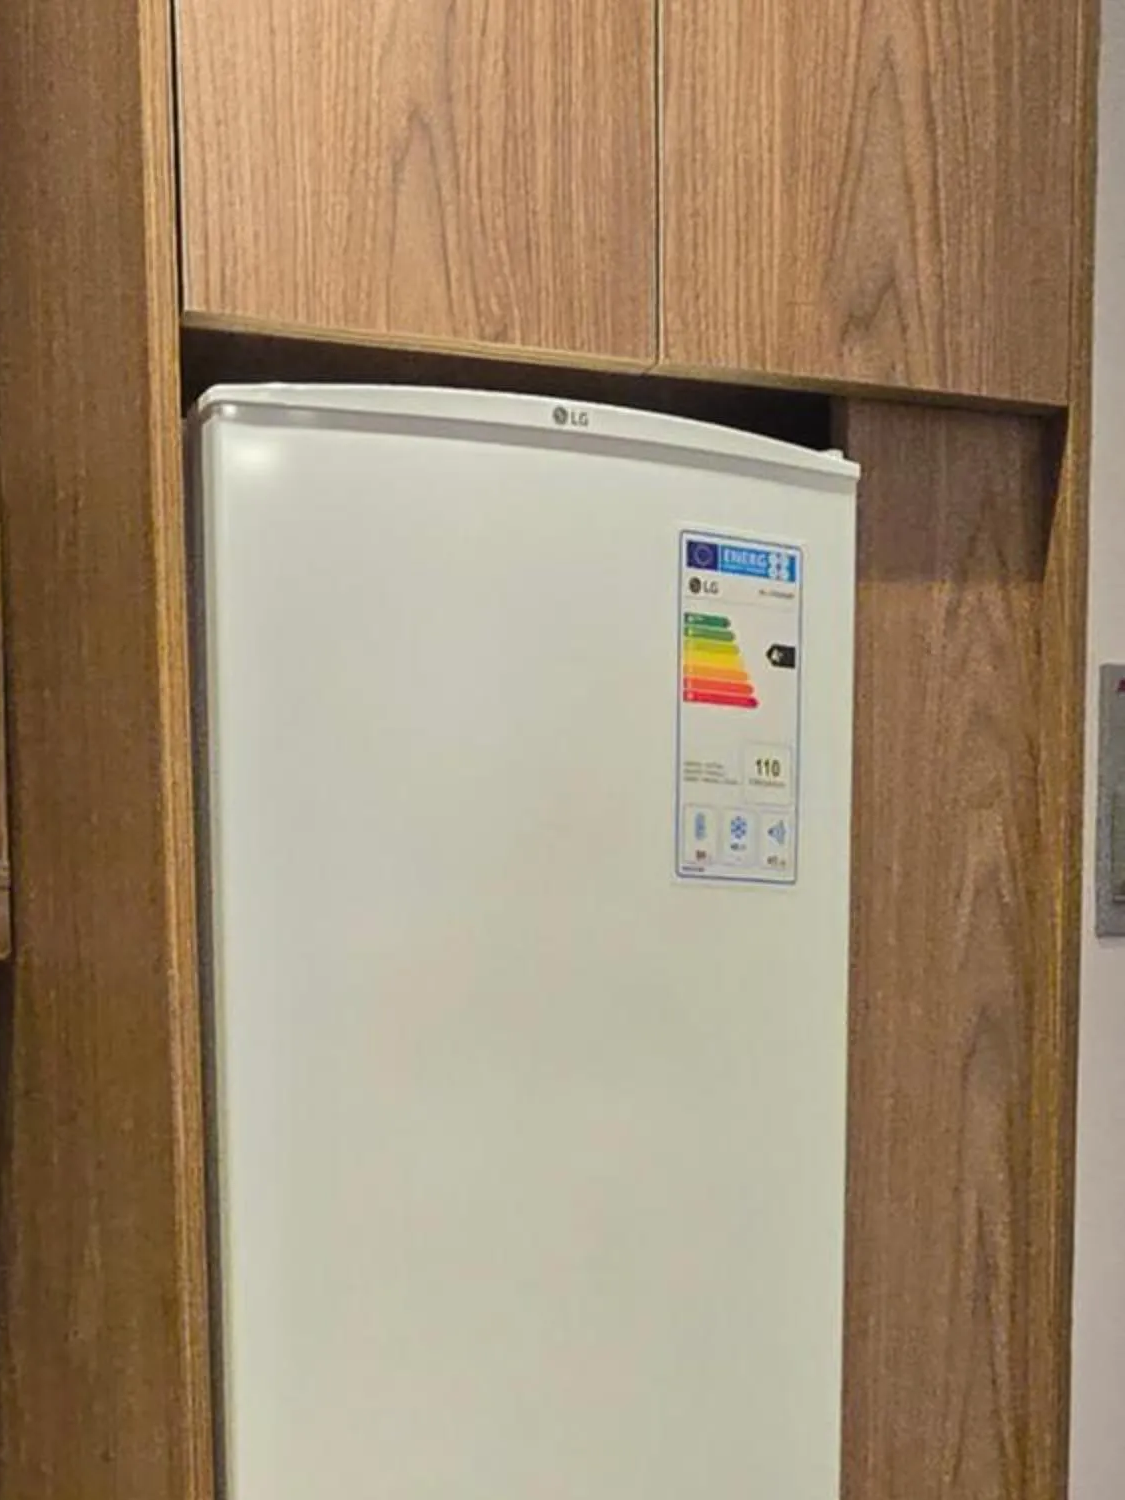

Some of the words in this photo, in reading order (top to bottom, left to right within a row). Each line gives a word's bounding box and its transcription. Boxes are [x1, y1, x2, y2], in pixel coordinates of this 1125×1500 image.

[570, 411, 589, 427] LG
[703, 581, 719, 594] LG
[755, 758, 781, 777] 110
